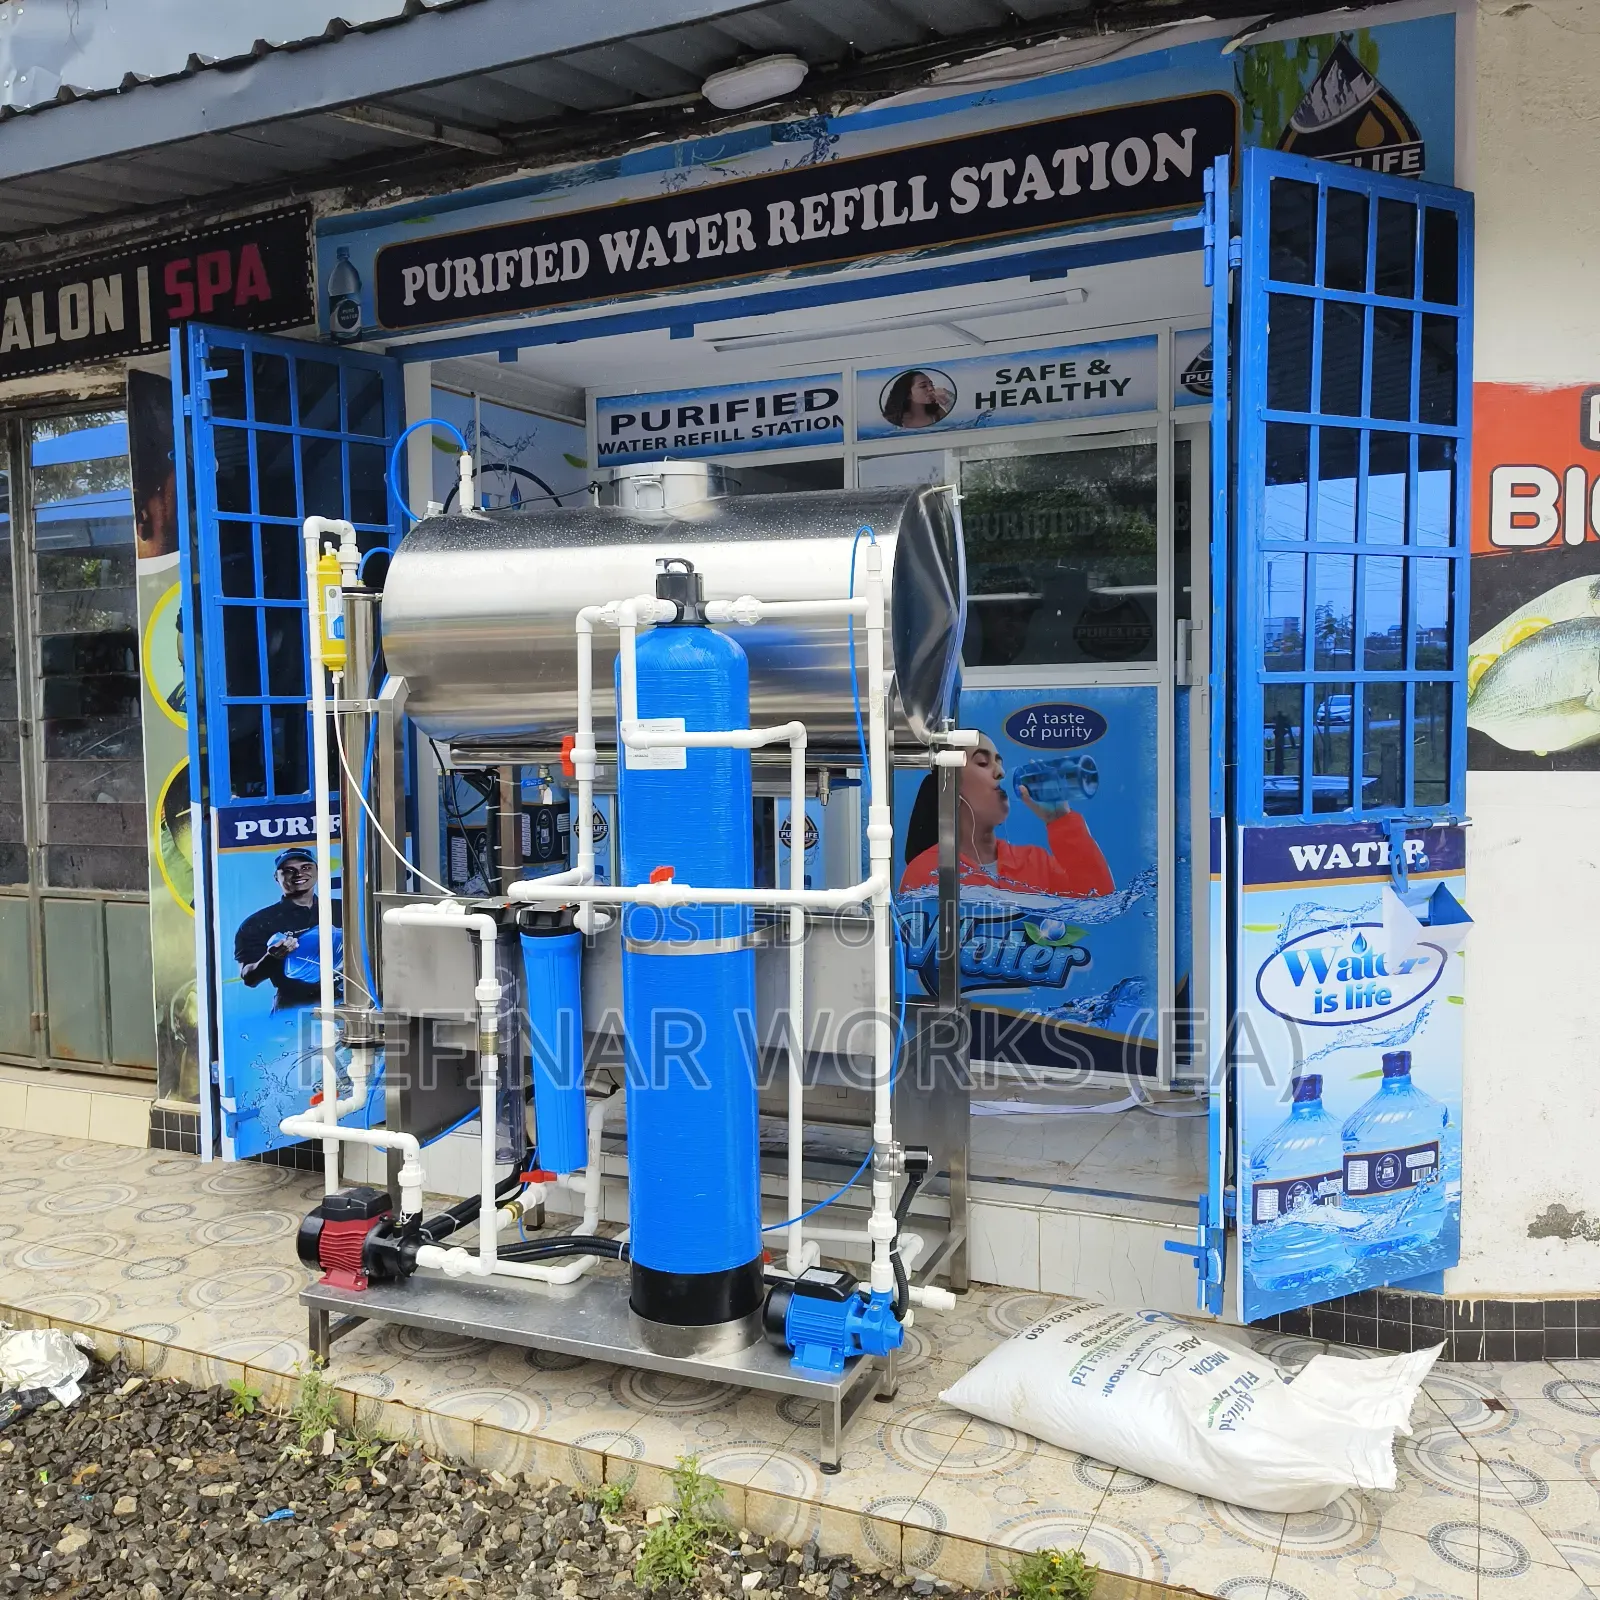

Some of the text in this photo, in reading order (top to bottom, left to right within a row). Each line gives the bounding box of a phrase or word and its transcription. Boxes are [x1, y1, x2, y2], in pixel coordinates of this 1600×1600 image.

[402, 127, 1197, 306] PURIFIED WATER REFILL STATION
[0, 273, 125, 352] ALON
[164, 243, 272, 319] SPA
[995, 359, 1112, 385] SAFE &
[975, 377, 1132, 409] HEALTHY
[610, 388, 839, 436] PURIFIED
[597, 414, 844, 455] WATER REFILL STATION
[1076, 626, 1152, 639] PURELIFE
[1026, 712, 1085, 724] A taste
[1019, 725, 1093, 741] of purity
[1313, 983, 1392, 1014] is life
[1025, 1322, 1051, 1340] 560
[1189, 1351, 1231, 1376] MEDIA
